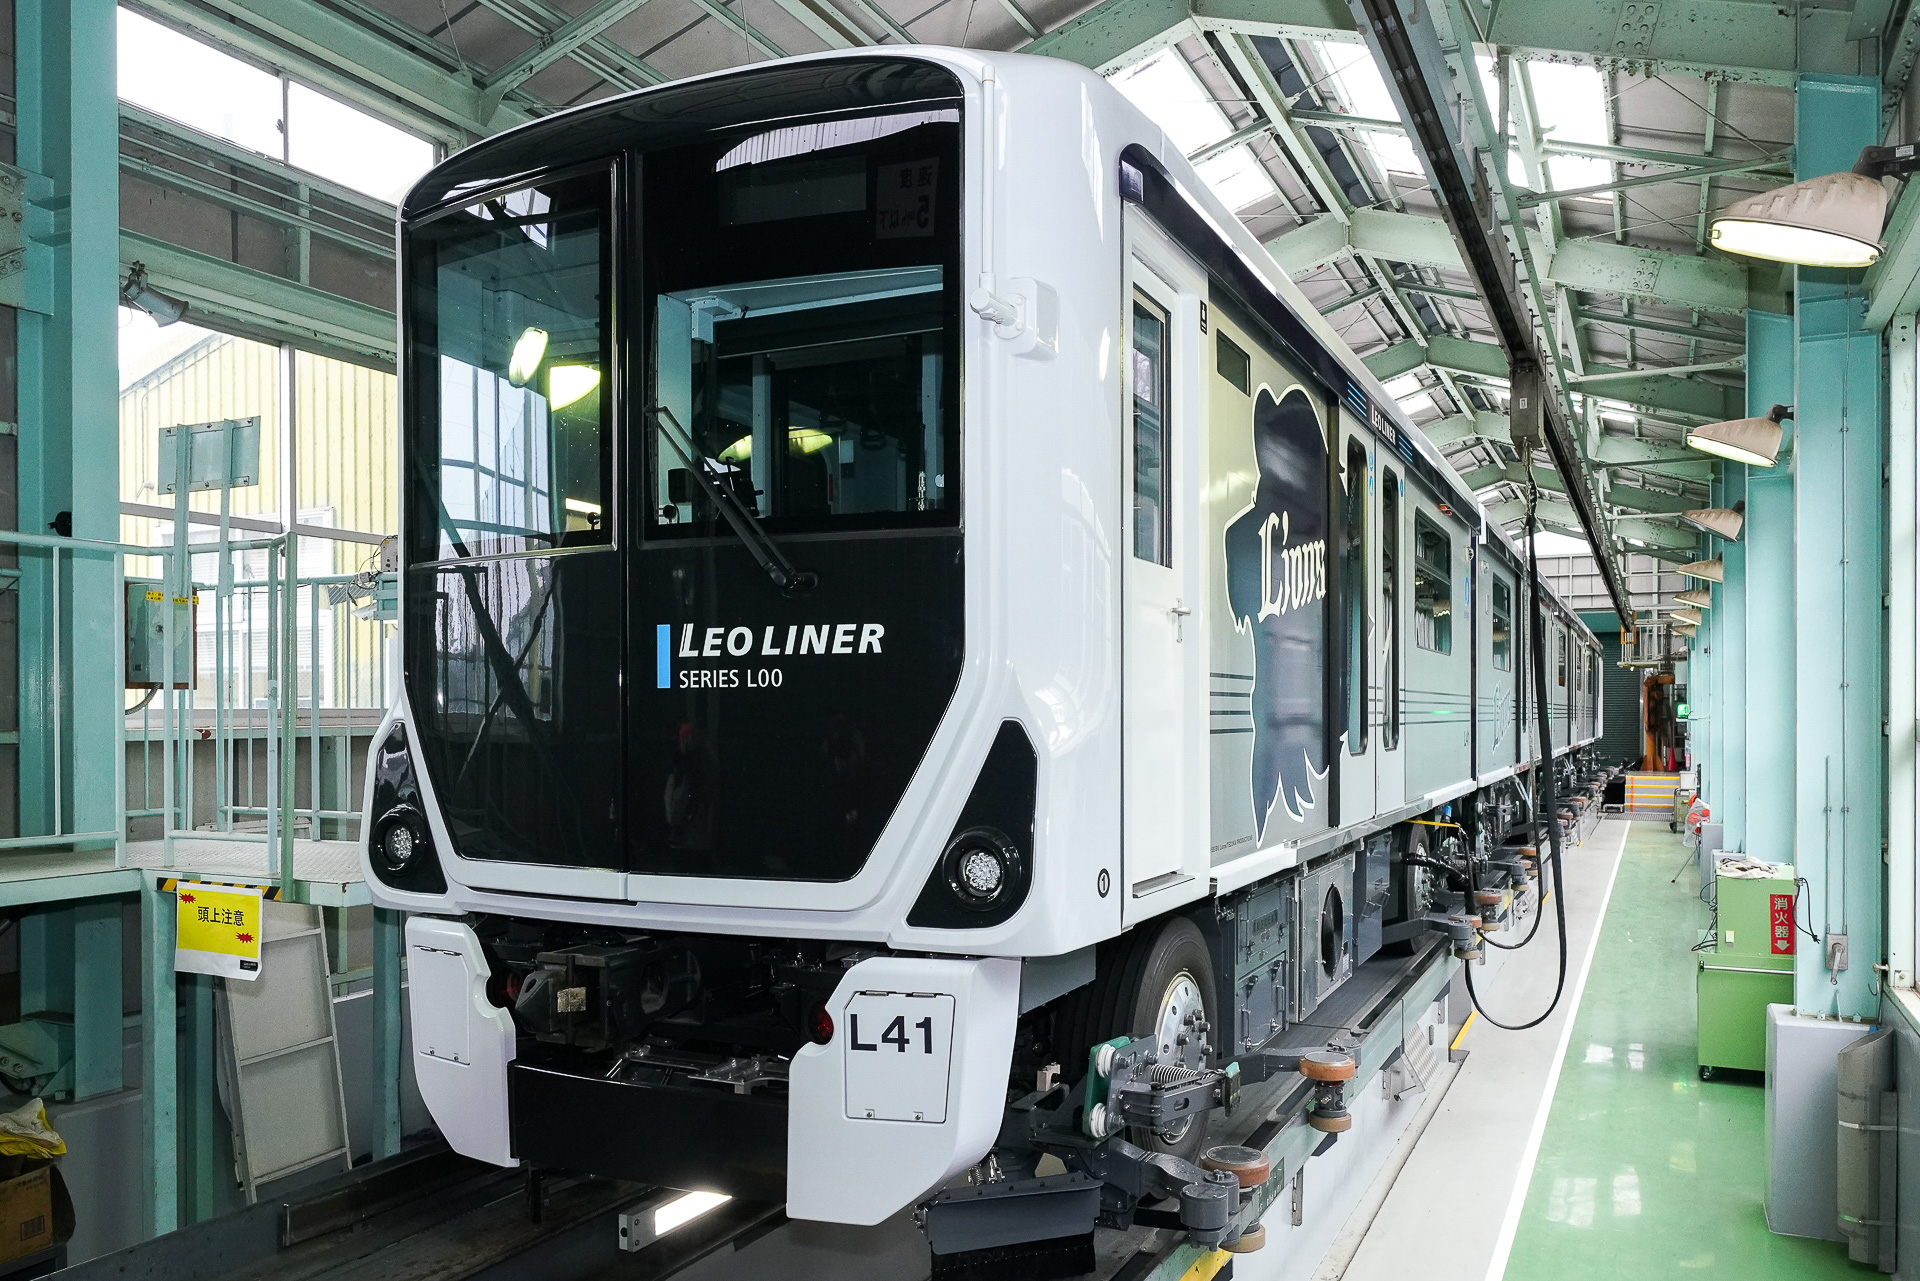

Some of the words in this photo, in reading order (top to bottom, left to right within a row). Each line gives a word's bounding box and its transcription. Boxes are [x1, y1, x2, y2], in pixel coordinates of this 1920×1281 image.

[1371, 404, 1382, 431] LEO
[1381, 417, 1396, 445] LINER
[1257, 510, 1326, 624] Lions
[678, 623, 753, 657] LEO
[761, 623, 885, 655] LINER
[679, 669, 739, 688] SERIES
[747, 668, 783, 688] L00
[197, 905, 245, 927] 頭上注意
[1774, 897, 1789, 938] 消火器
[850, 1013, 932, 1054] L41
